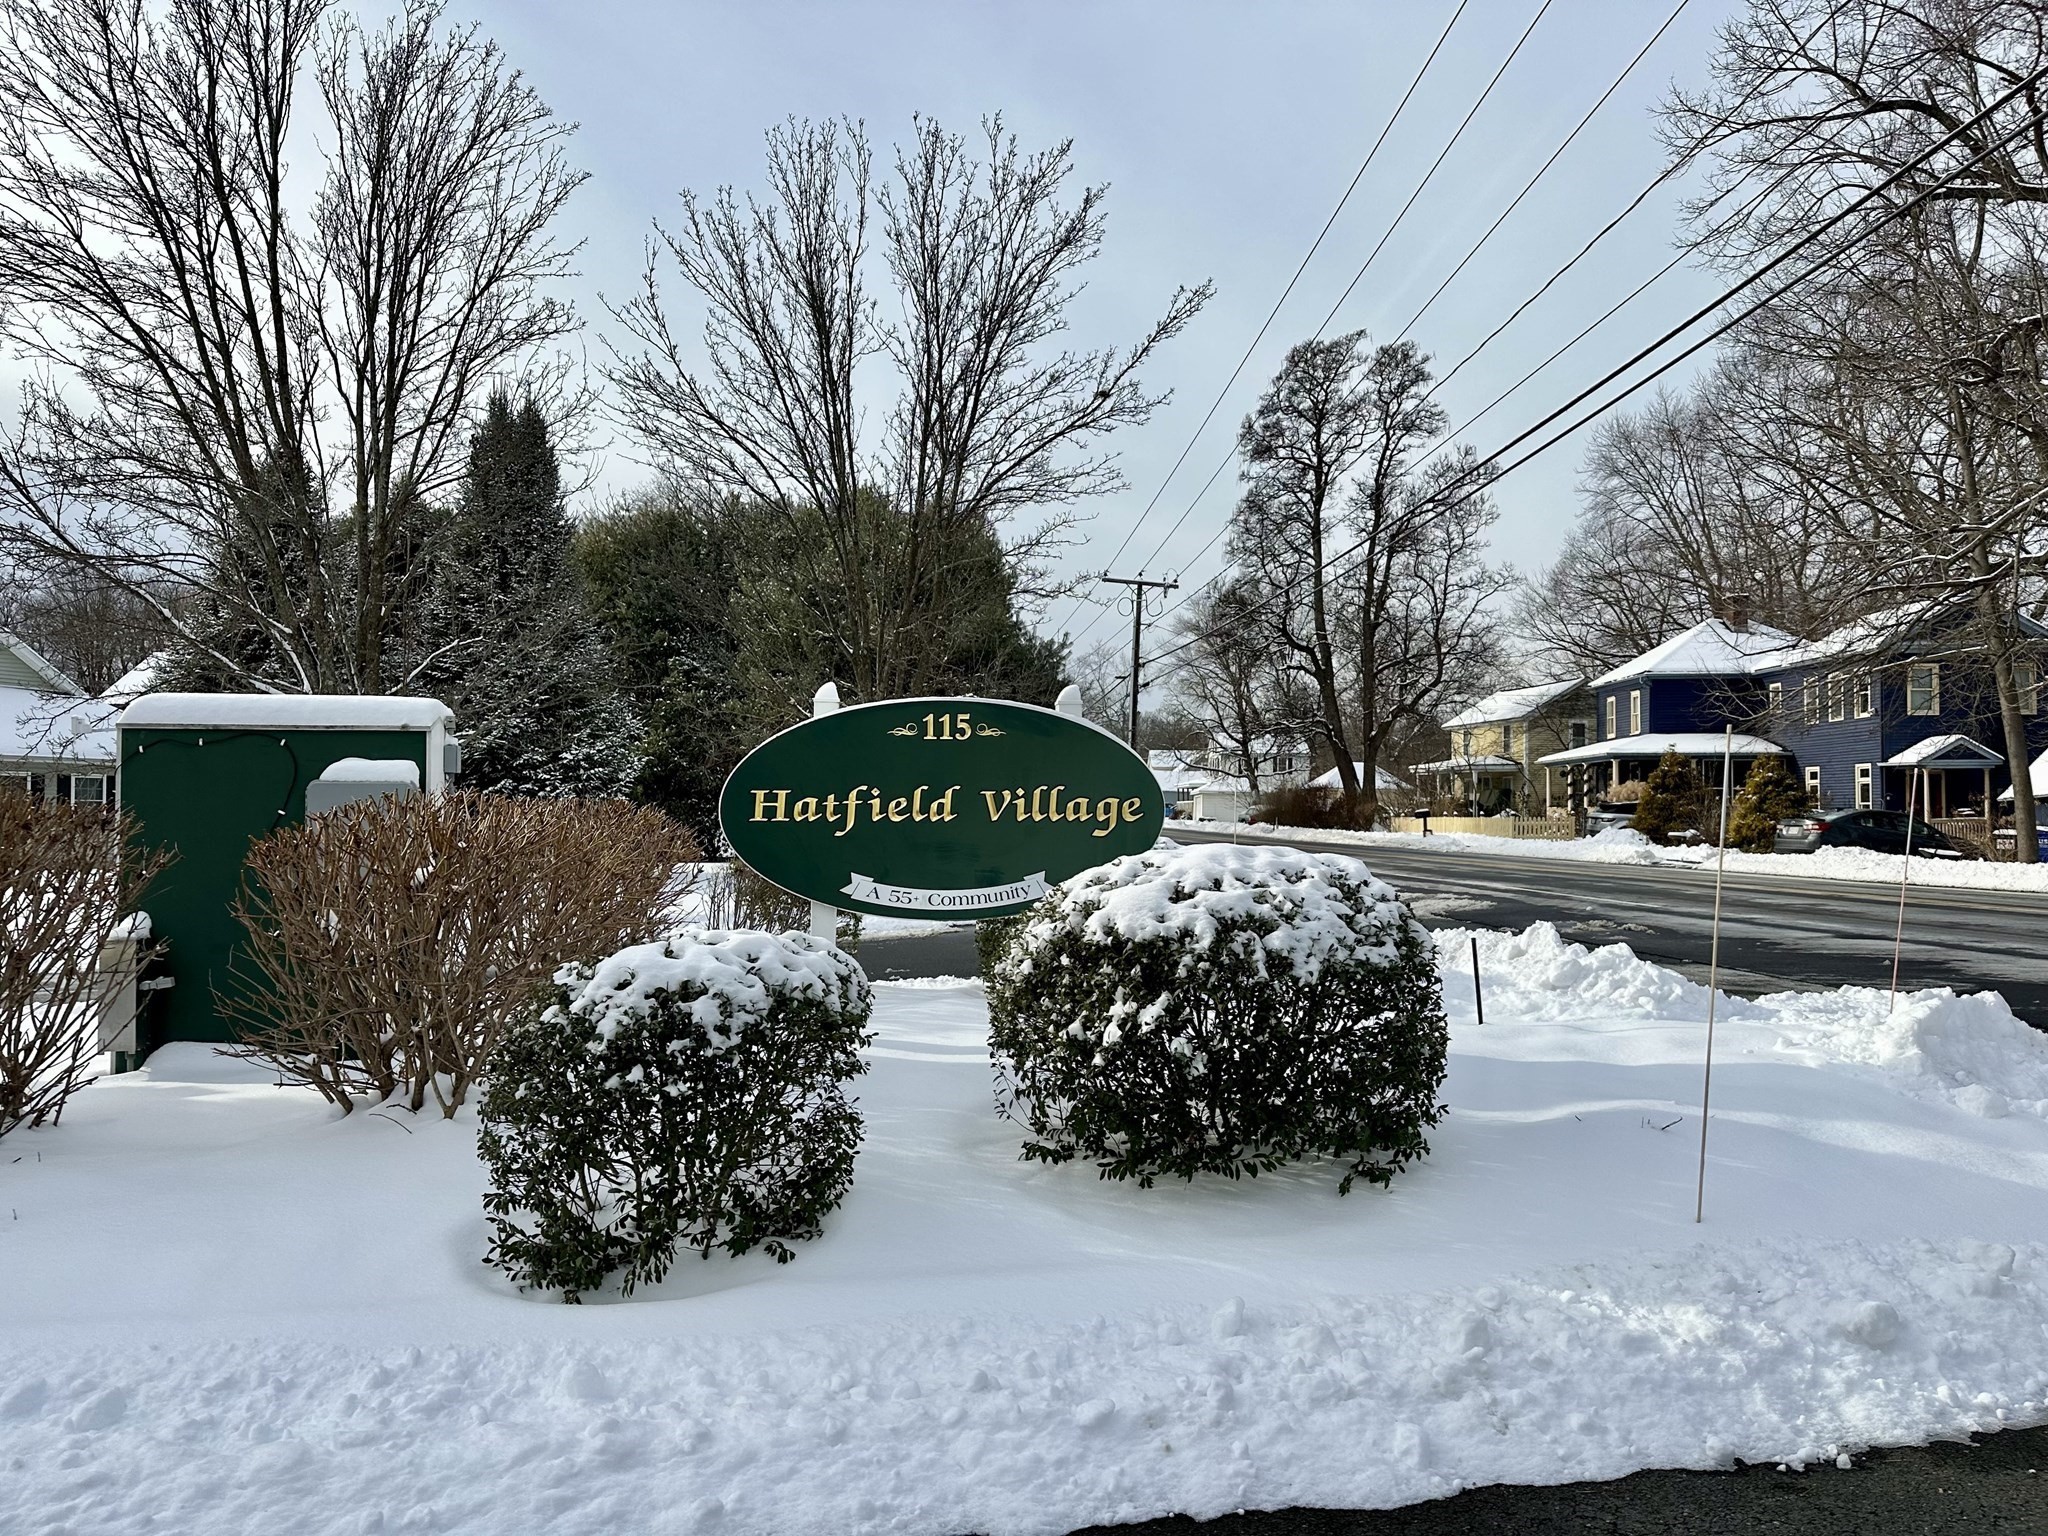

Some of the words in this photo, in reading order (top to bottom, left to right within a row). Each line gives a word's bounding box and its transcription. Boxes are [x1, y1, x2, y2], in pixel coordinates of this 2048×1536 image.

[922, 713, 971, 740] 115
[749, 785, 961, 836] Hatfield
[980, 785, 1144, 836] Village
[866, 887, 880, 900] A
[888, 890, 919, 904] 55+
[928, 884, 1031, 906] Community
